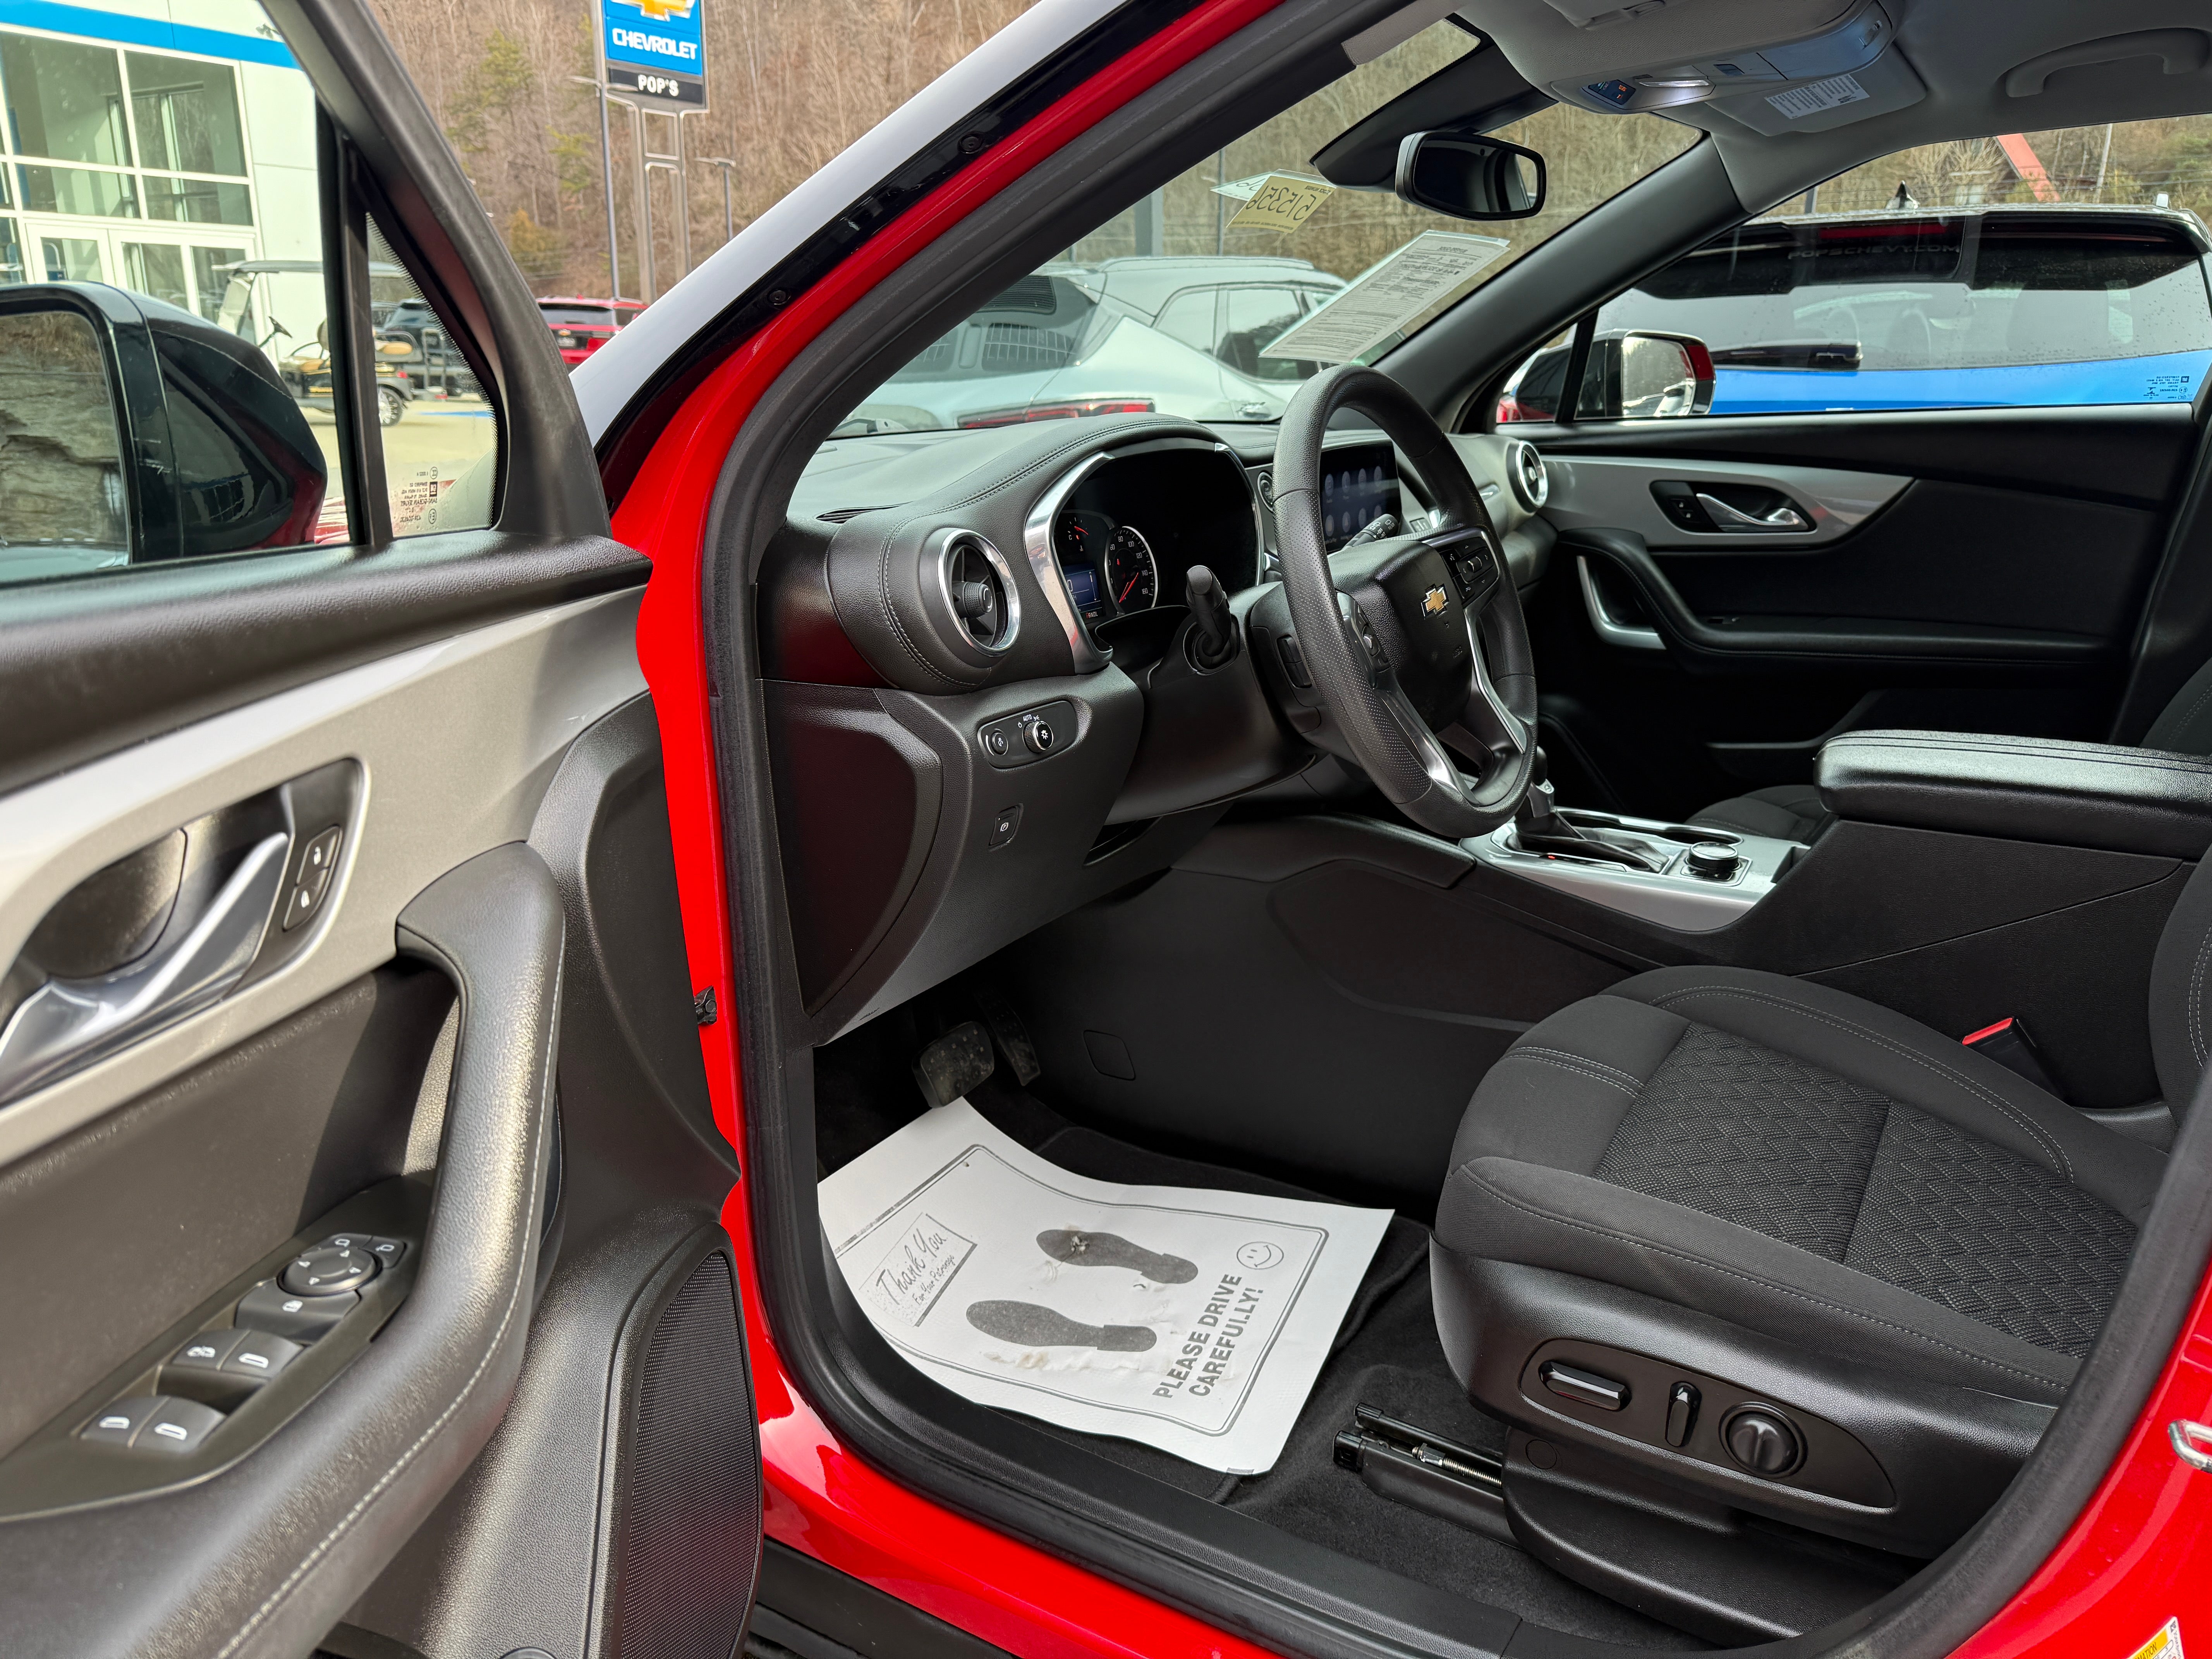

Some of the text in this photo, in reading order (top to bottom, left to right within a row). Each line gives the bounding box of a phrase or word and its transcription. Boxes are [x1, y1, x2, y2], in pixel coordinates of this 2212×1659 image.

[612, 27, 697, 60] CHEVROLET
[638, 74, 679, 97] POP'S
[876, 1228, 946, 1305] Thank You
[1152, 1274, 1242, 1398] PLEASE DRIVE
[1188, 1287, 1264, 1396] CAREFULLY!
